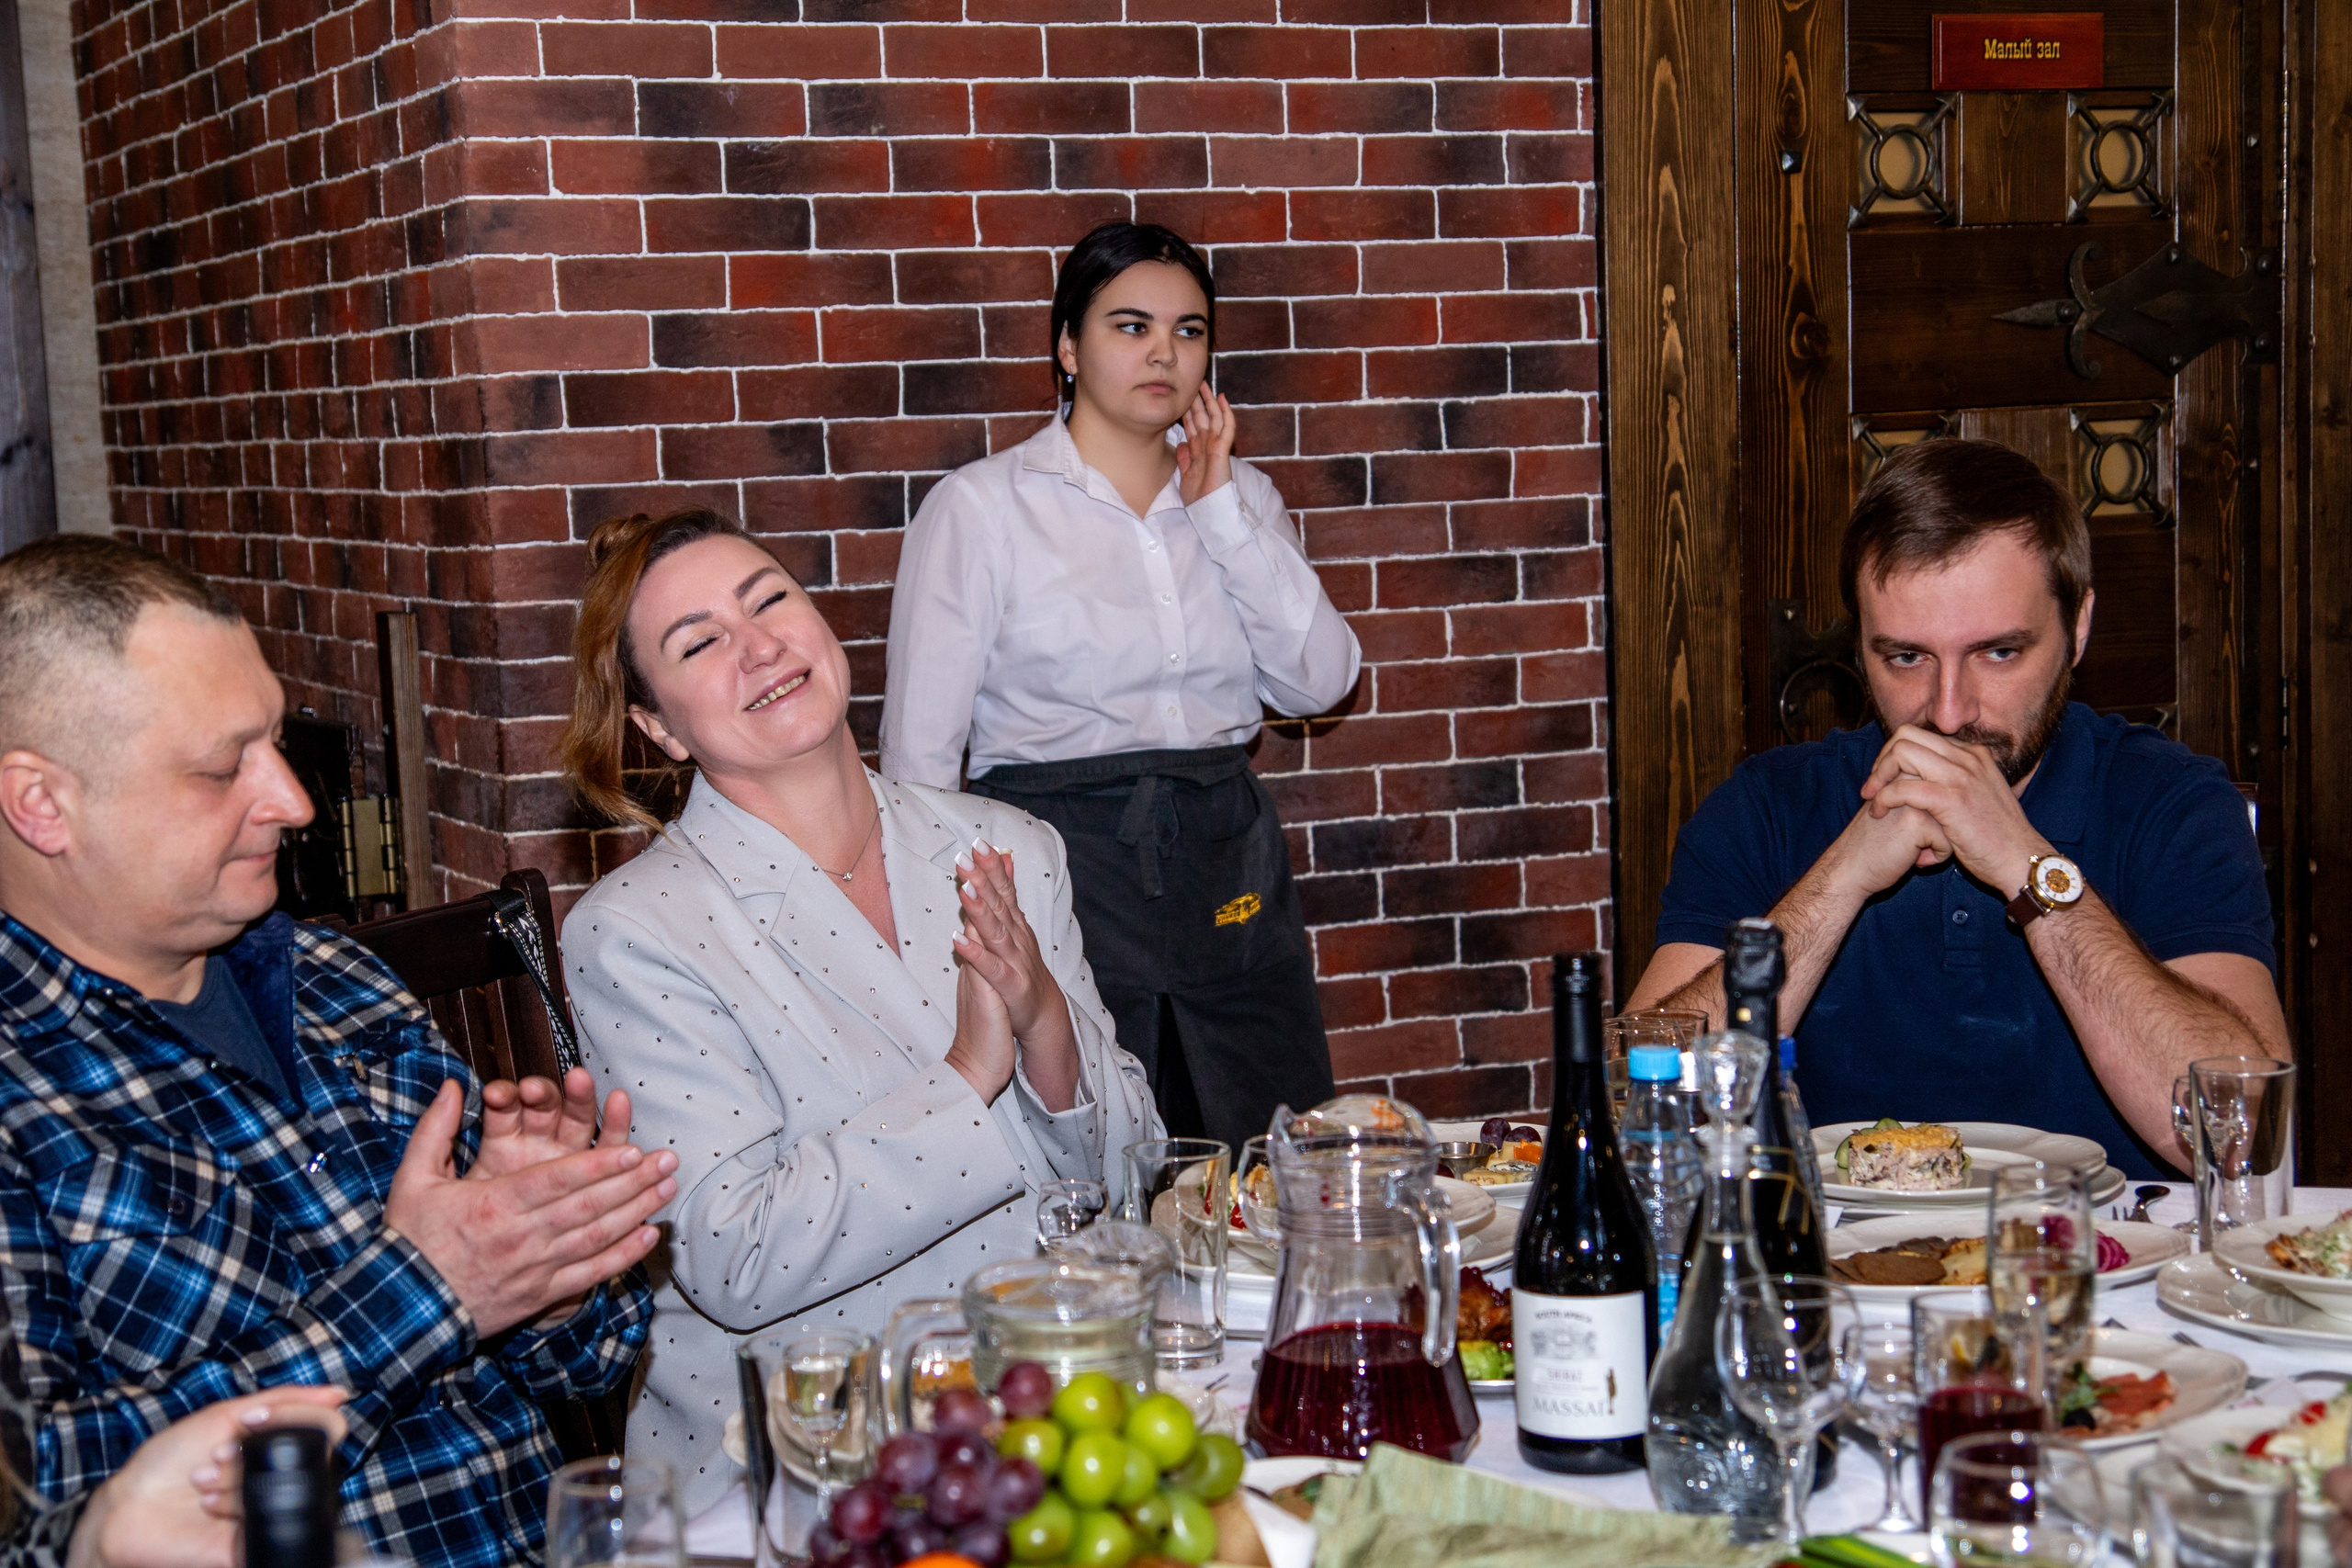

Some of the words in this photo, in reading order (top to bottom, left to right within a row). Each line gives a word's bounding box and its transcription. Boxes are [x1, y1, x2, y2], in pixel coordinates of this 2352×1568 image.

[1984, 38, 2032, 60] Малый
[2036, 40, 2061, 59] зал
[1532, 1395, 1604, 1417] MASSAI
